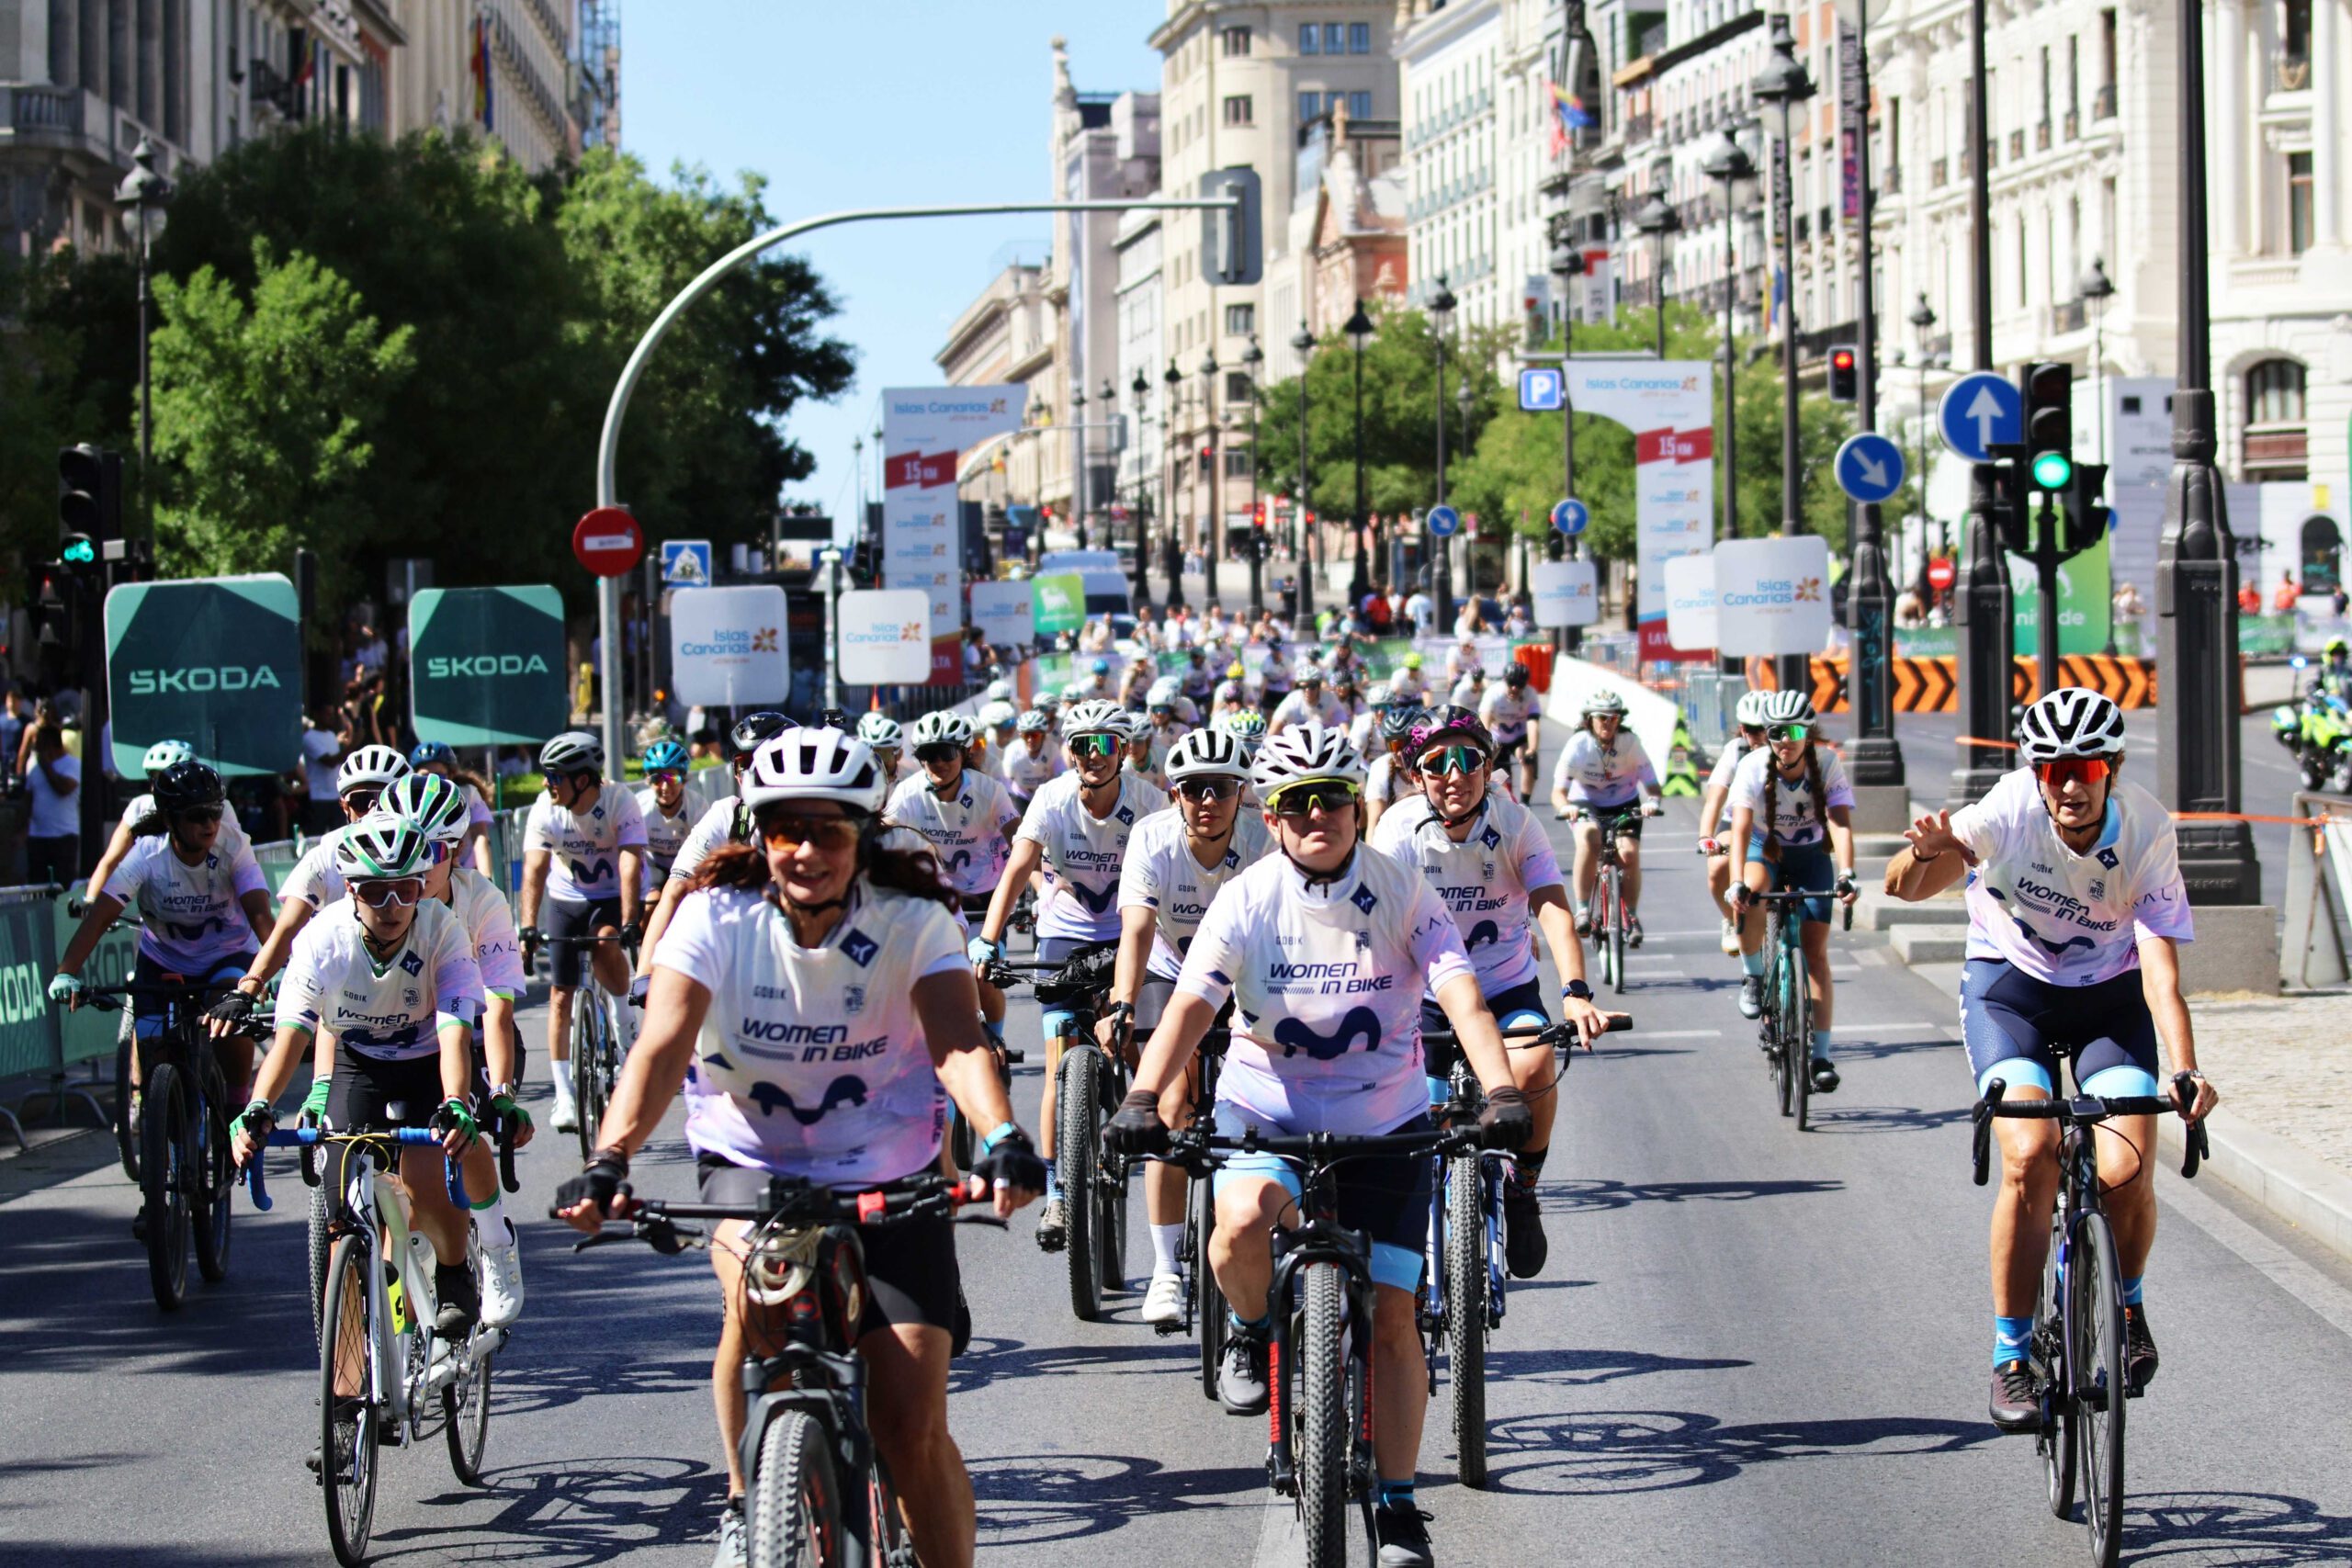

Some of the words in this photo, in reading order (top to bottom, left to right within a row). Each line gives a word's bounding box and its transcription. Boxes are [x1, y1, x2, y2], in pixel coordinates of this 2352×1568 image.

[1586, 378, 1617, 389] Islas
[1620, 378, 1679, 389] Canarias
[894, 401, 925, 413] Islas
[928, 401, 989, 413] Canarias
[1658, 436, 1676, 456] 15
[904, 461, 922, 480] 15
[1756, 580, 1792, 592] Islas
[1724, 592, 1792, 606] Canarias
[871, 622, 899, 633] Islas
[714, 629, 749, 642] Islas
[846, 632, 899, 643] Canarias
[681, 642, 750, 656] Canarias
[1066, 850, 1117, 863] WOMEN
[1095, 864, 1106, 873] IN
[164, 895, 211, 906] WOMEN
[1455, 900, 1471, 912] IN
[1476, 894, 1509, 911] BIKE
[2017, 877, 2091, 917] WOMEN
[190, 905, 201, 913] IN
[204, 900, 230, 913] BIKE
[2054, 907, 2076, 920] IN
[2075, 915, 2117, 932] BIKE
[1270, 963, 1358, 978] WOMEN
[1320, 981, 1341, 994] IN
[1346, 975, 1393, 993] BIKE
[344, 990, 368, 1002] GOBIK
[337, 1007, 410, 1025] WOMEN
[742, 1017, 848, 1043] WOMEN
[800, 1045, 829, 1063] IN
[831, 1034, 889, 1062] BIKE
